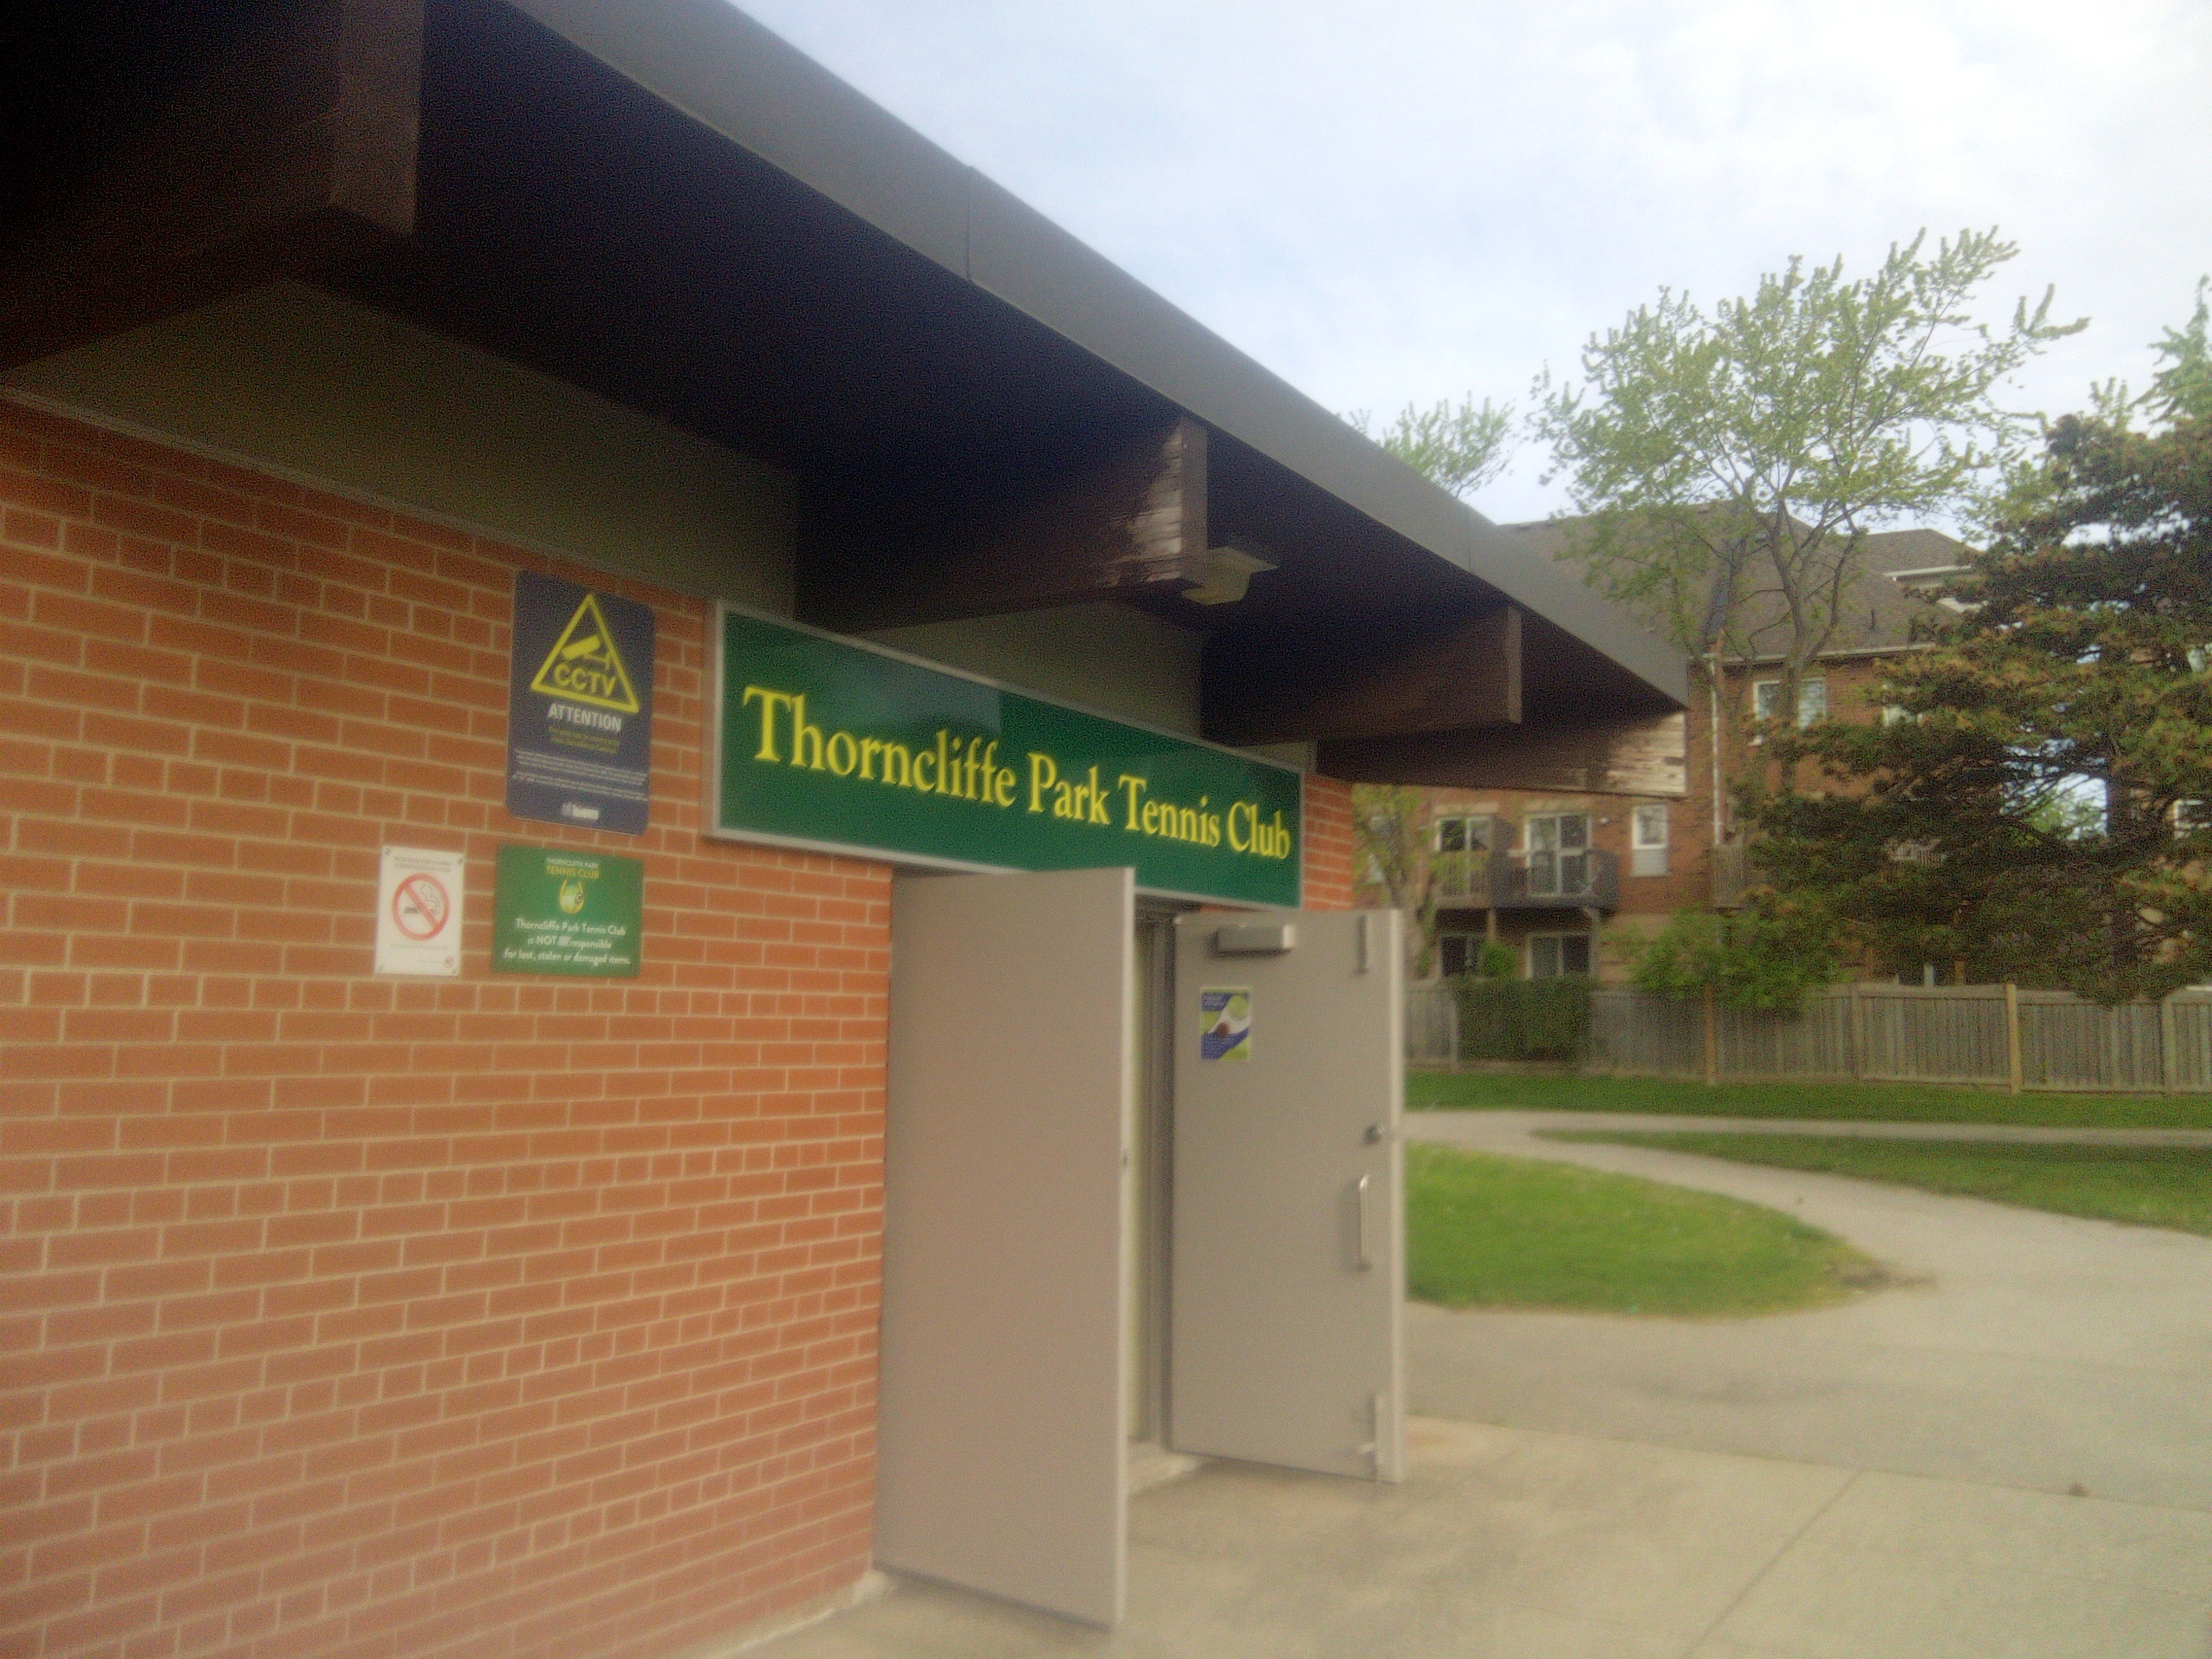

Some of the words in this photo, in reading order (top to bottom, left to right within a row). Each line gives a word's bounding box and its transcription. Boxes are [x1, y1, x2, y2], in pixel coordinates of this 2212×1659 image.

[555, 663, 616, 697] CCTV
[548, 703, 621, 731] ATTENTION
[743, 685, 1017, 807] Thorncliffe
[1027, 752, 1111, 825] Park
[1118, 774, 1221, 847] Tennis
[1227, 800, 1291, 860] Club
[546, 865, 577, 877] TENNIS
[578, 869, 599, 879] CLUB
[516, 918, 560, 931] Thorncliffe
[562, 921, 580, 933] Park
[582, 923, 606, 934] Tennis
[607, 924, 626, 935] Club
[527, 936, 534, 945] is
[536, 936, 557, 945] NOT
[569, 939, 612, 950] responsible
[504, 949, 516, 959] for
[518, 949, 536, 961] lost,
[537, 951, 562, 961] stolen
[564, 954, 572, 962] or
[573, 952, 607, 966] damaged
[609, 955, 631, 964] items.
